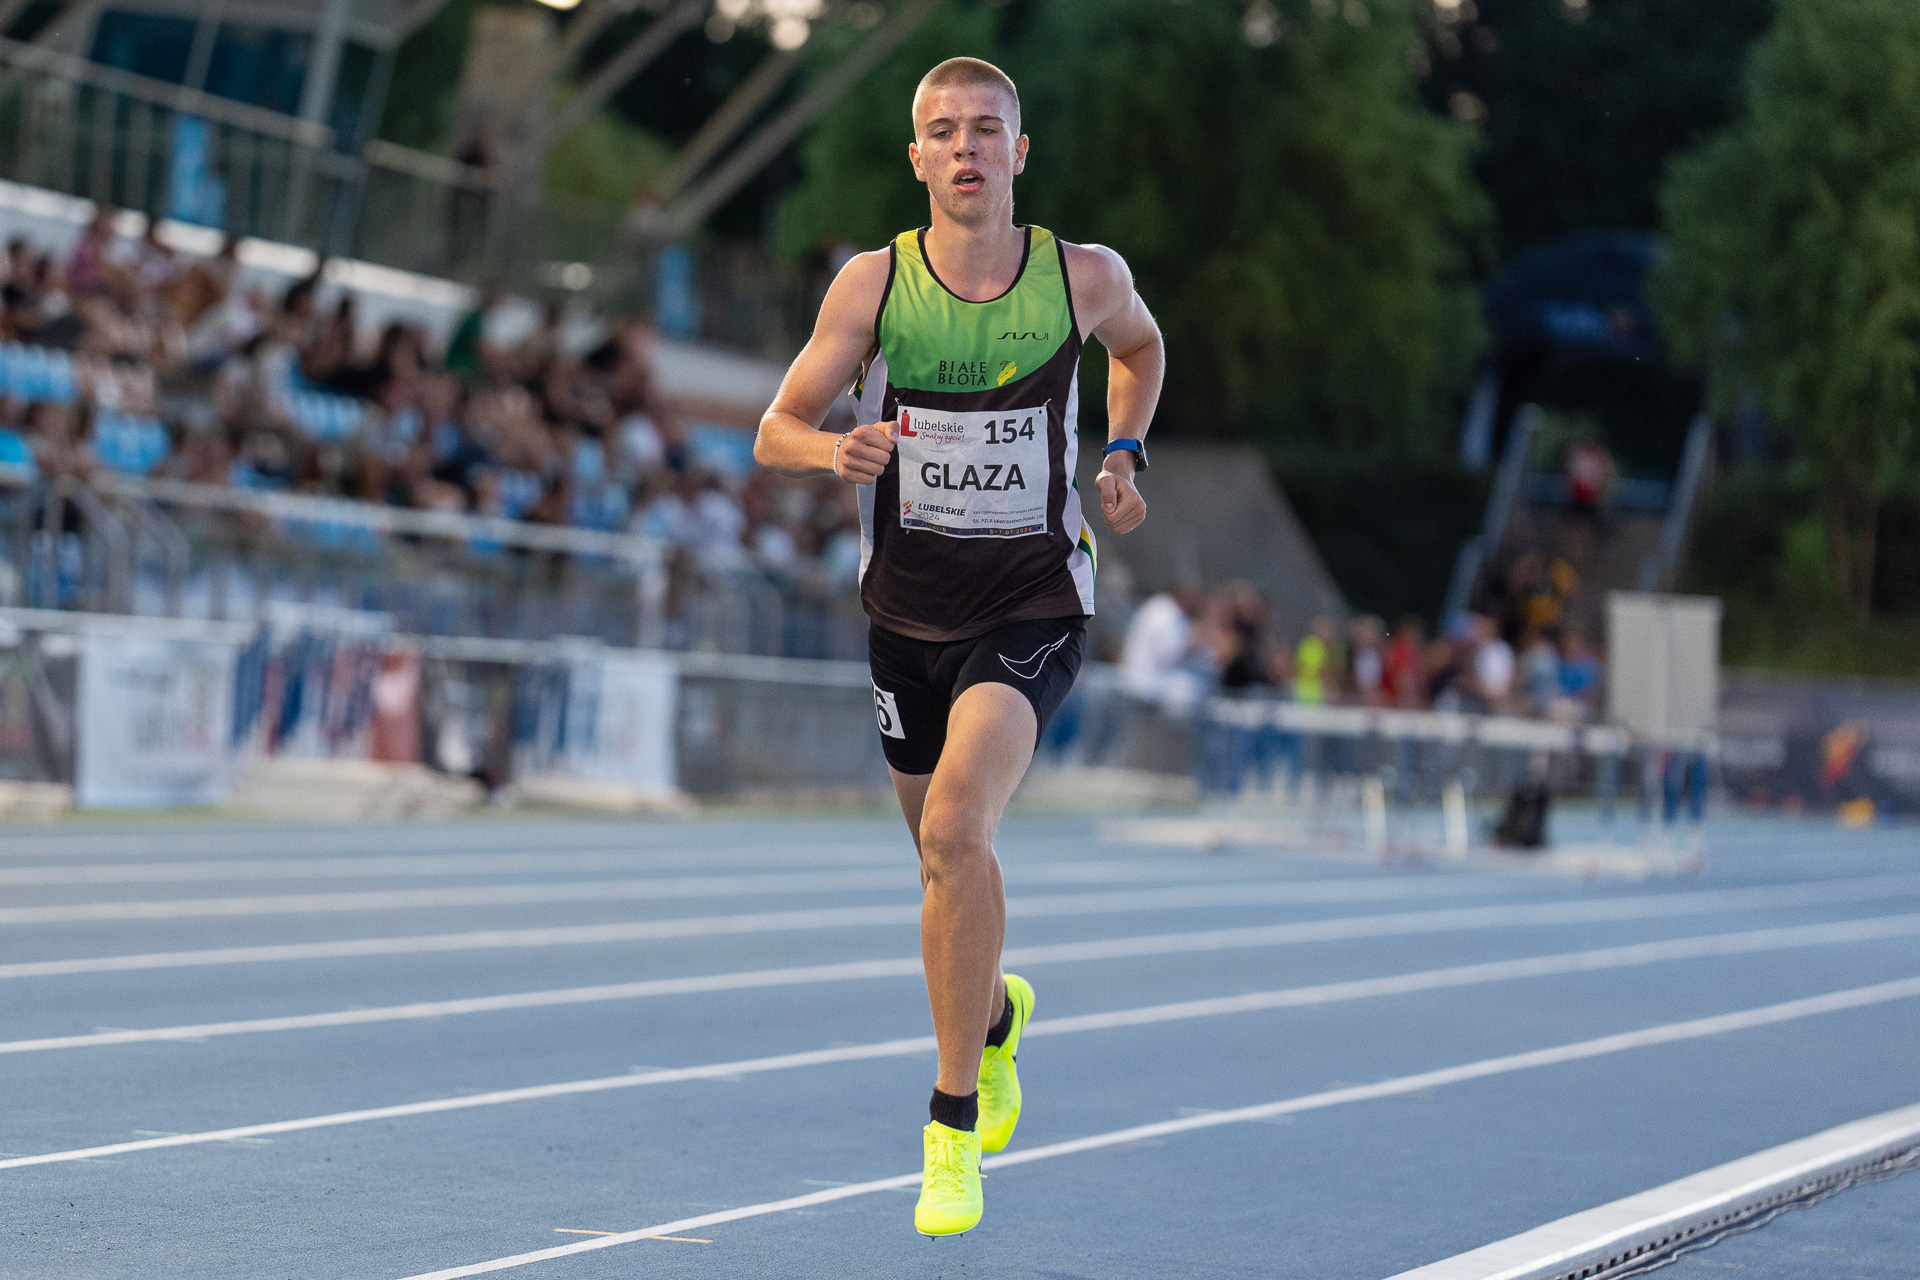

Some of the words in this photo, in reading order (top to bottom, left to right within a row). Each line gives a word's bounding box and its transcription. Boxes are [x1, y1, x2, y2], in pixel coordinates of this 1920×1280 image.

[938, 360, 987, 374] BIAŁE
[937, 373, 988, 386] BŁOTA
[914, 418, 964, 434] lubelskie
[983, 416, 1035, 445] 154
[920, 461, 1026, 491] GLAZA
[917, 503, 967, 517] LUBELSKIE
[918, 511, 940, 521] 2024
[874, 689, 893, 732] 6
